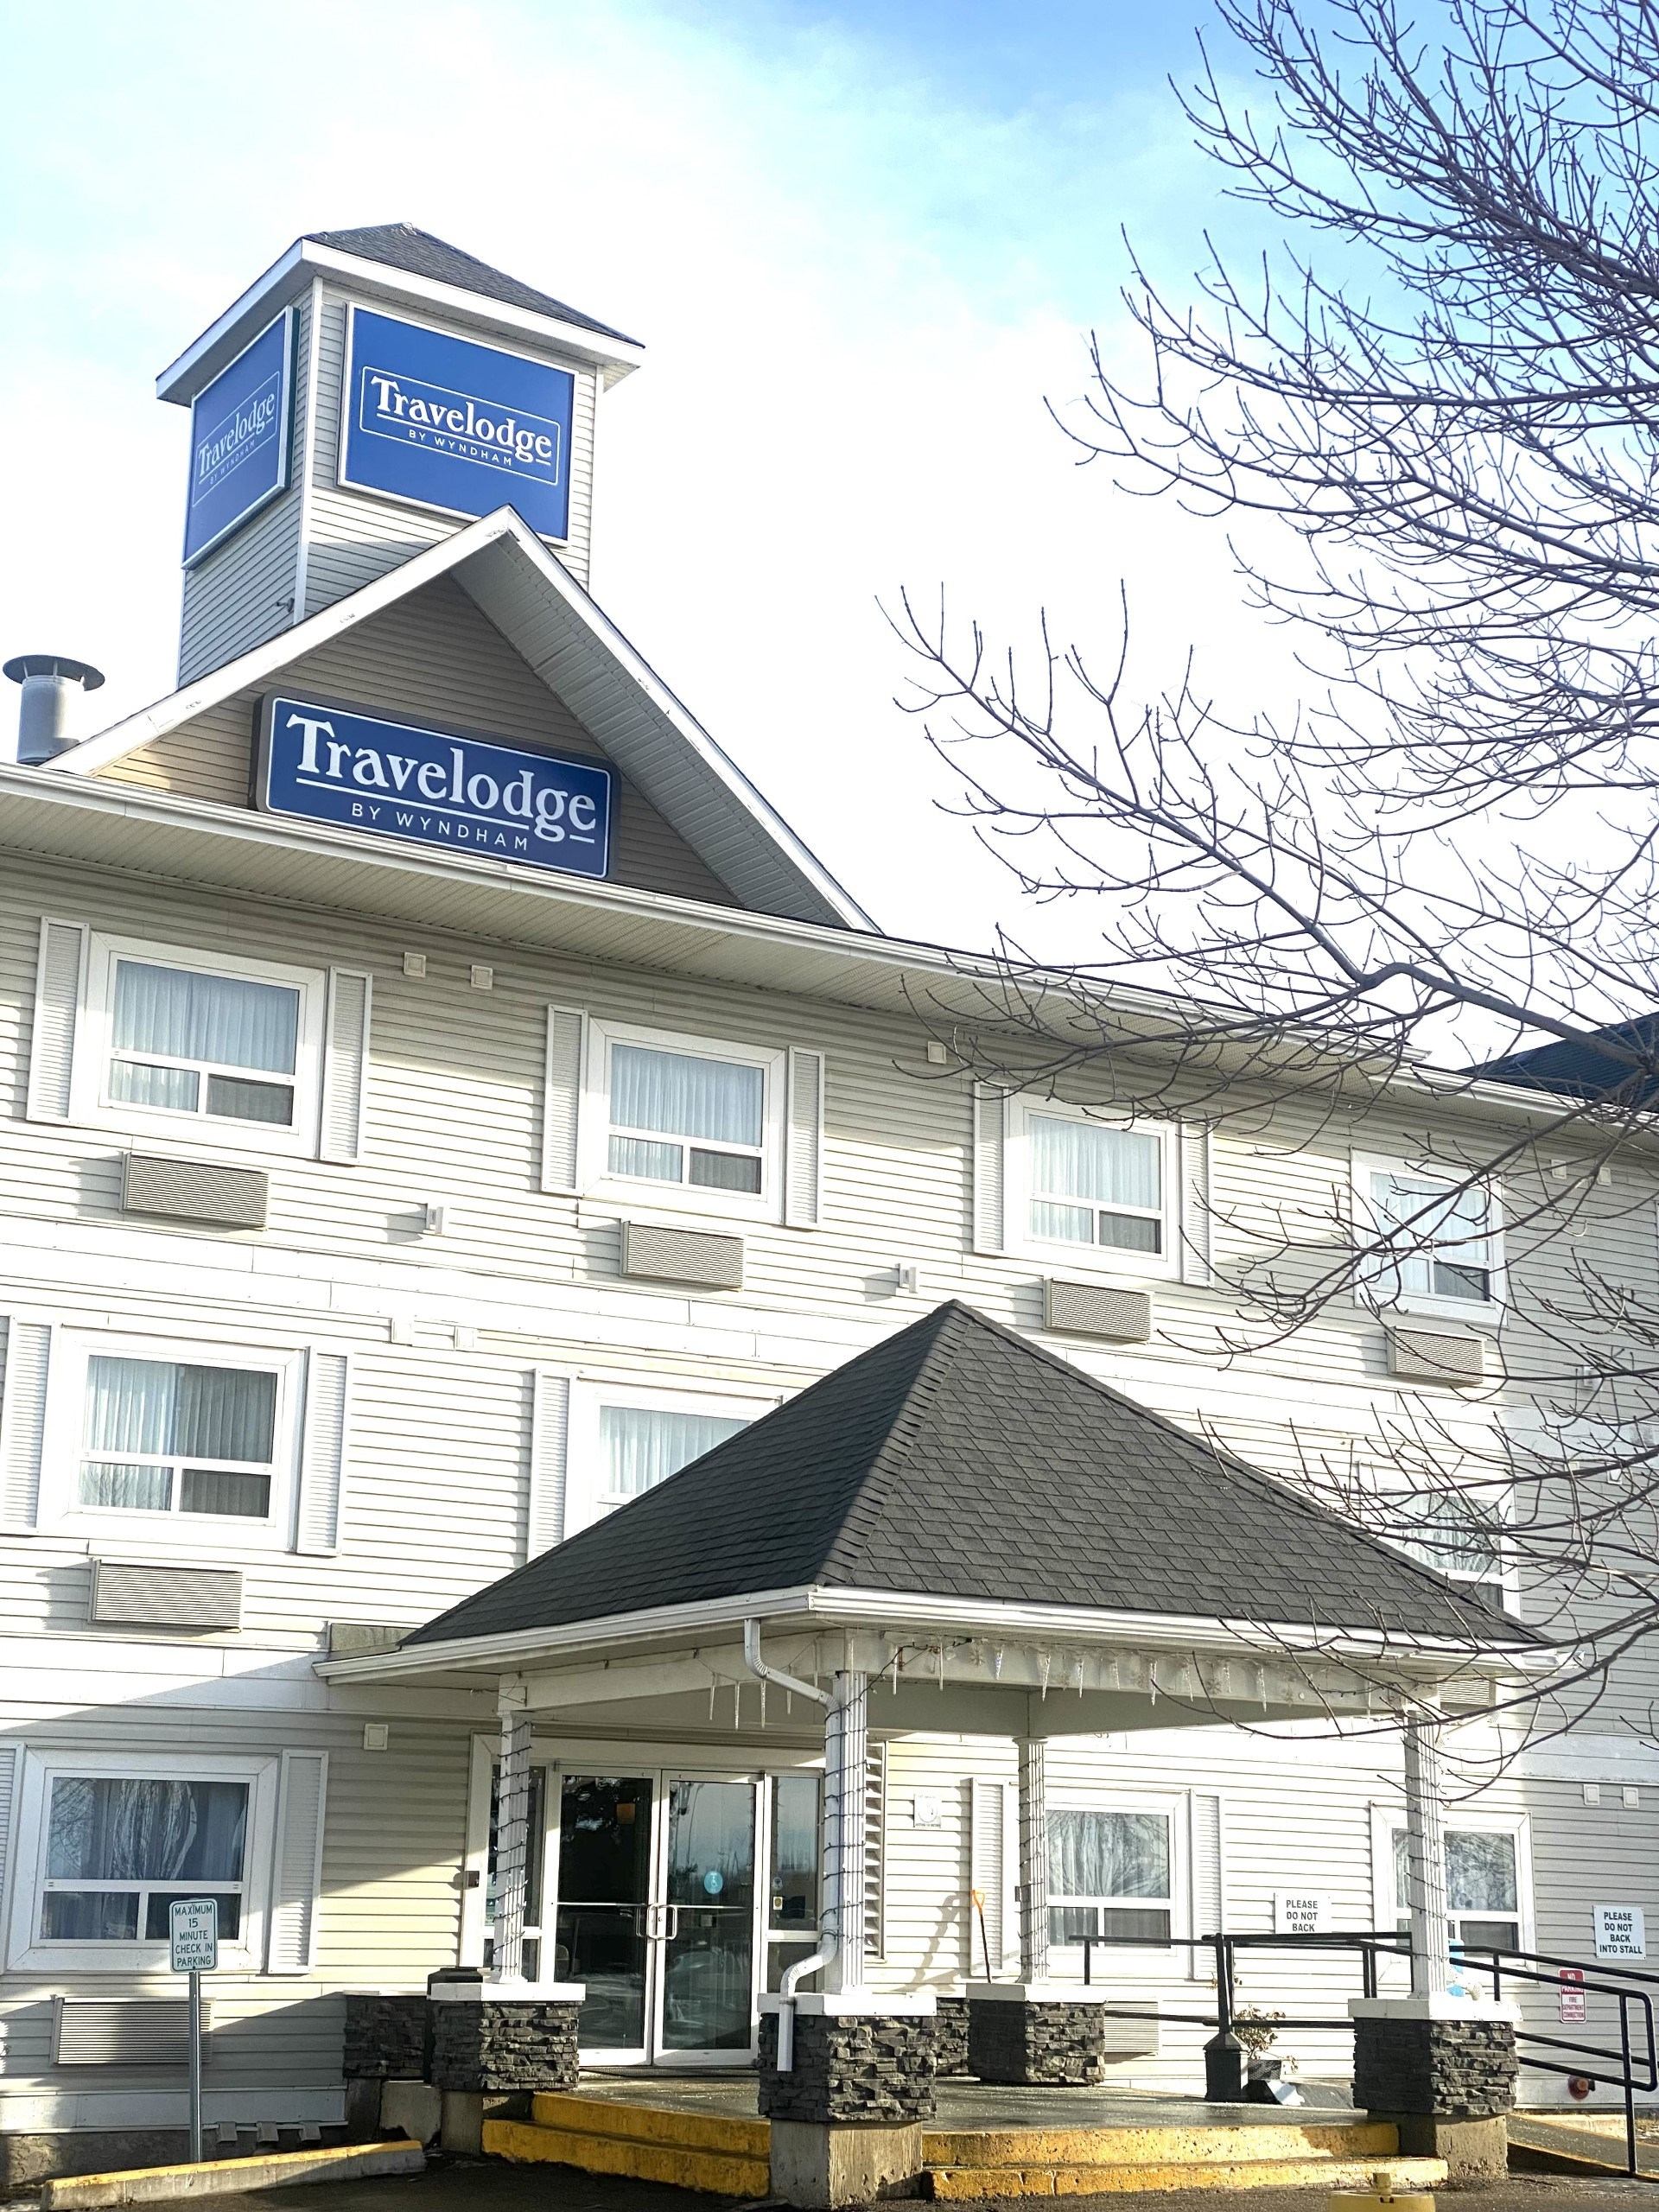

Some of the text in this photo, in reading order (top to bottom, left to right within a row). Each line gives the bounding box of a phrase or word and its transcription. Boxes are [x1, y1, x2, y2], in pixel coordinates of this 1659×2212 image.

[370, 375, 553, 464] Travelodge
[198, 393, 275, 478] Travelodge
[409, 429, 512, 467] BY WYNDHAM
[220, 439, 255, 475] WYNDHAM
[285, 713, 597, 842] Travelodge
[352, 803, 528, 851] BY WYNDHAM
[175, 1904, 213, 1916] MAXIMUM
[1286, 1899, 1319, 1909] PLEASE
[1286, 1911, 1319, 1921] DO NOT
[1604, 1911, 1632, 1921] PLEASE
[188, 1917, 199, 1928] 15
[1292, 1923, 1315, 1932] BACK
[1605, 1923, 1633, 1932] DO NOT
[179, 1929, 208, 1942] MINUTE
[1610, 1934, 1631, 1943] BACK
[175, 1942, 213, 1955] CHECK IN
[1599, 1944, 1643, 1955] INTO STALL
[176, 1955, 212, 1967] PARKING
